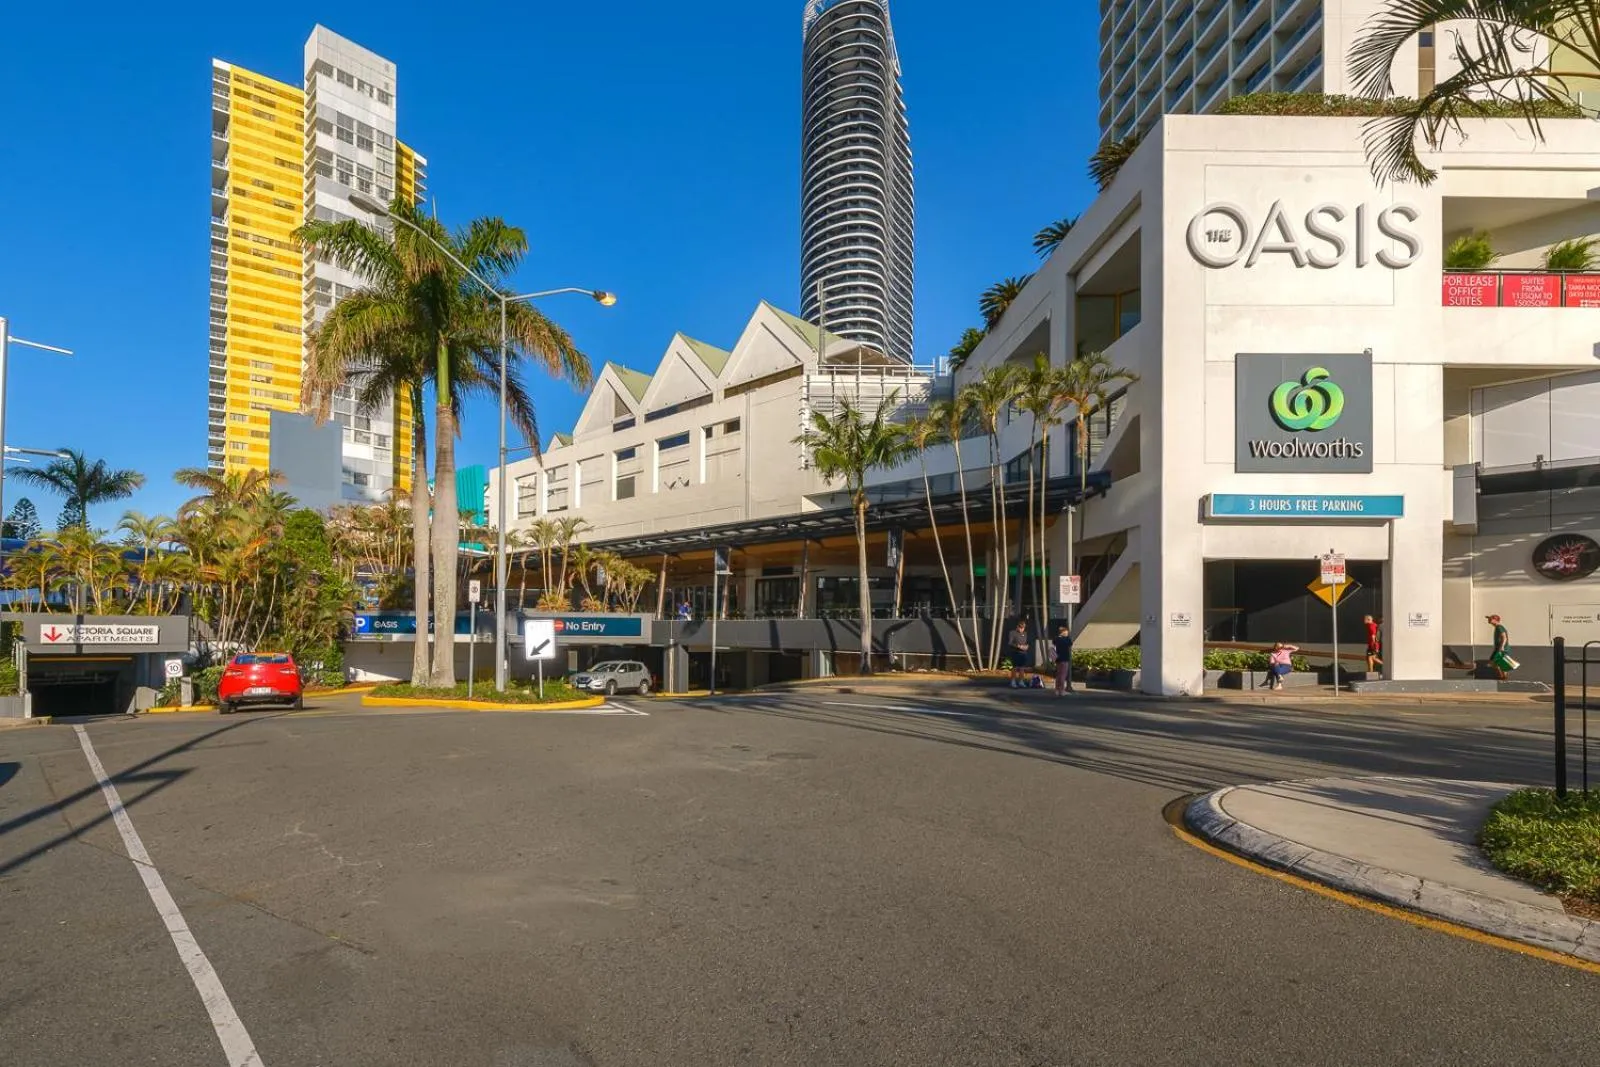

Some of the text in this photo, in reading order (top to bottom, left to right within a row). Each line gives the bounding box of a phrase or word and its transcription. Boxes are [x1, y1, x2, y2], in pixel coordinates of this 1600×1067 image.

[1186, 198, 1424, 270] OASIS
[1205, 229, 1232, 243] THE
[1443, 275, 1494, 286] FOR LEASE
[1520, 277, 1545, 285] SUITES
[1449, 286, 1483, 296] OFFICE
[1449, 296, 1483, 306] SUITES
[1249, 437, 1364, 458] Woolworths
[1249, 499, 1364, 511] 3 HOURS FREE PARKING
[66, 627, 154, 635] VICTORIA SQUARE
[565, 621, 606, 632] No Entry
